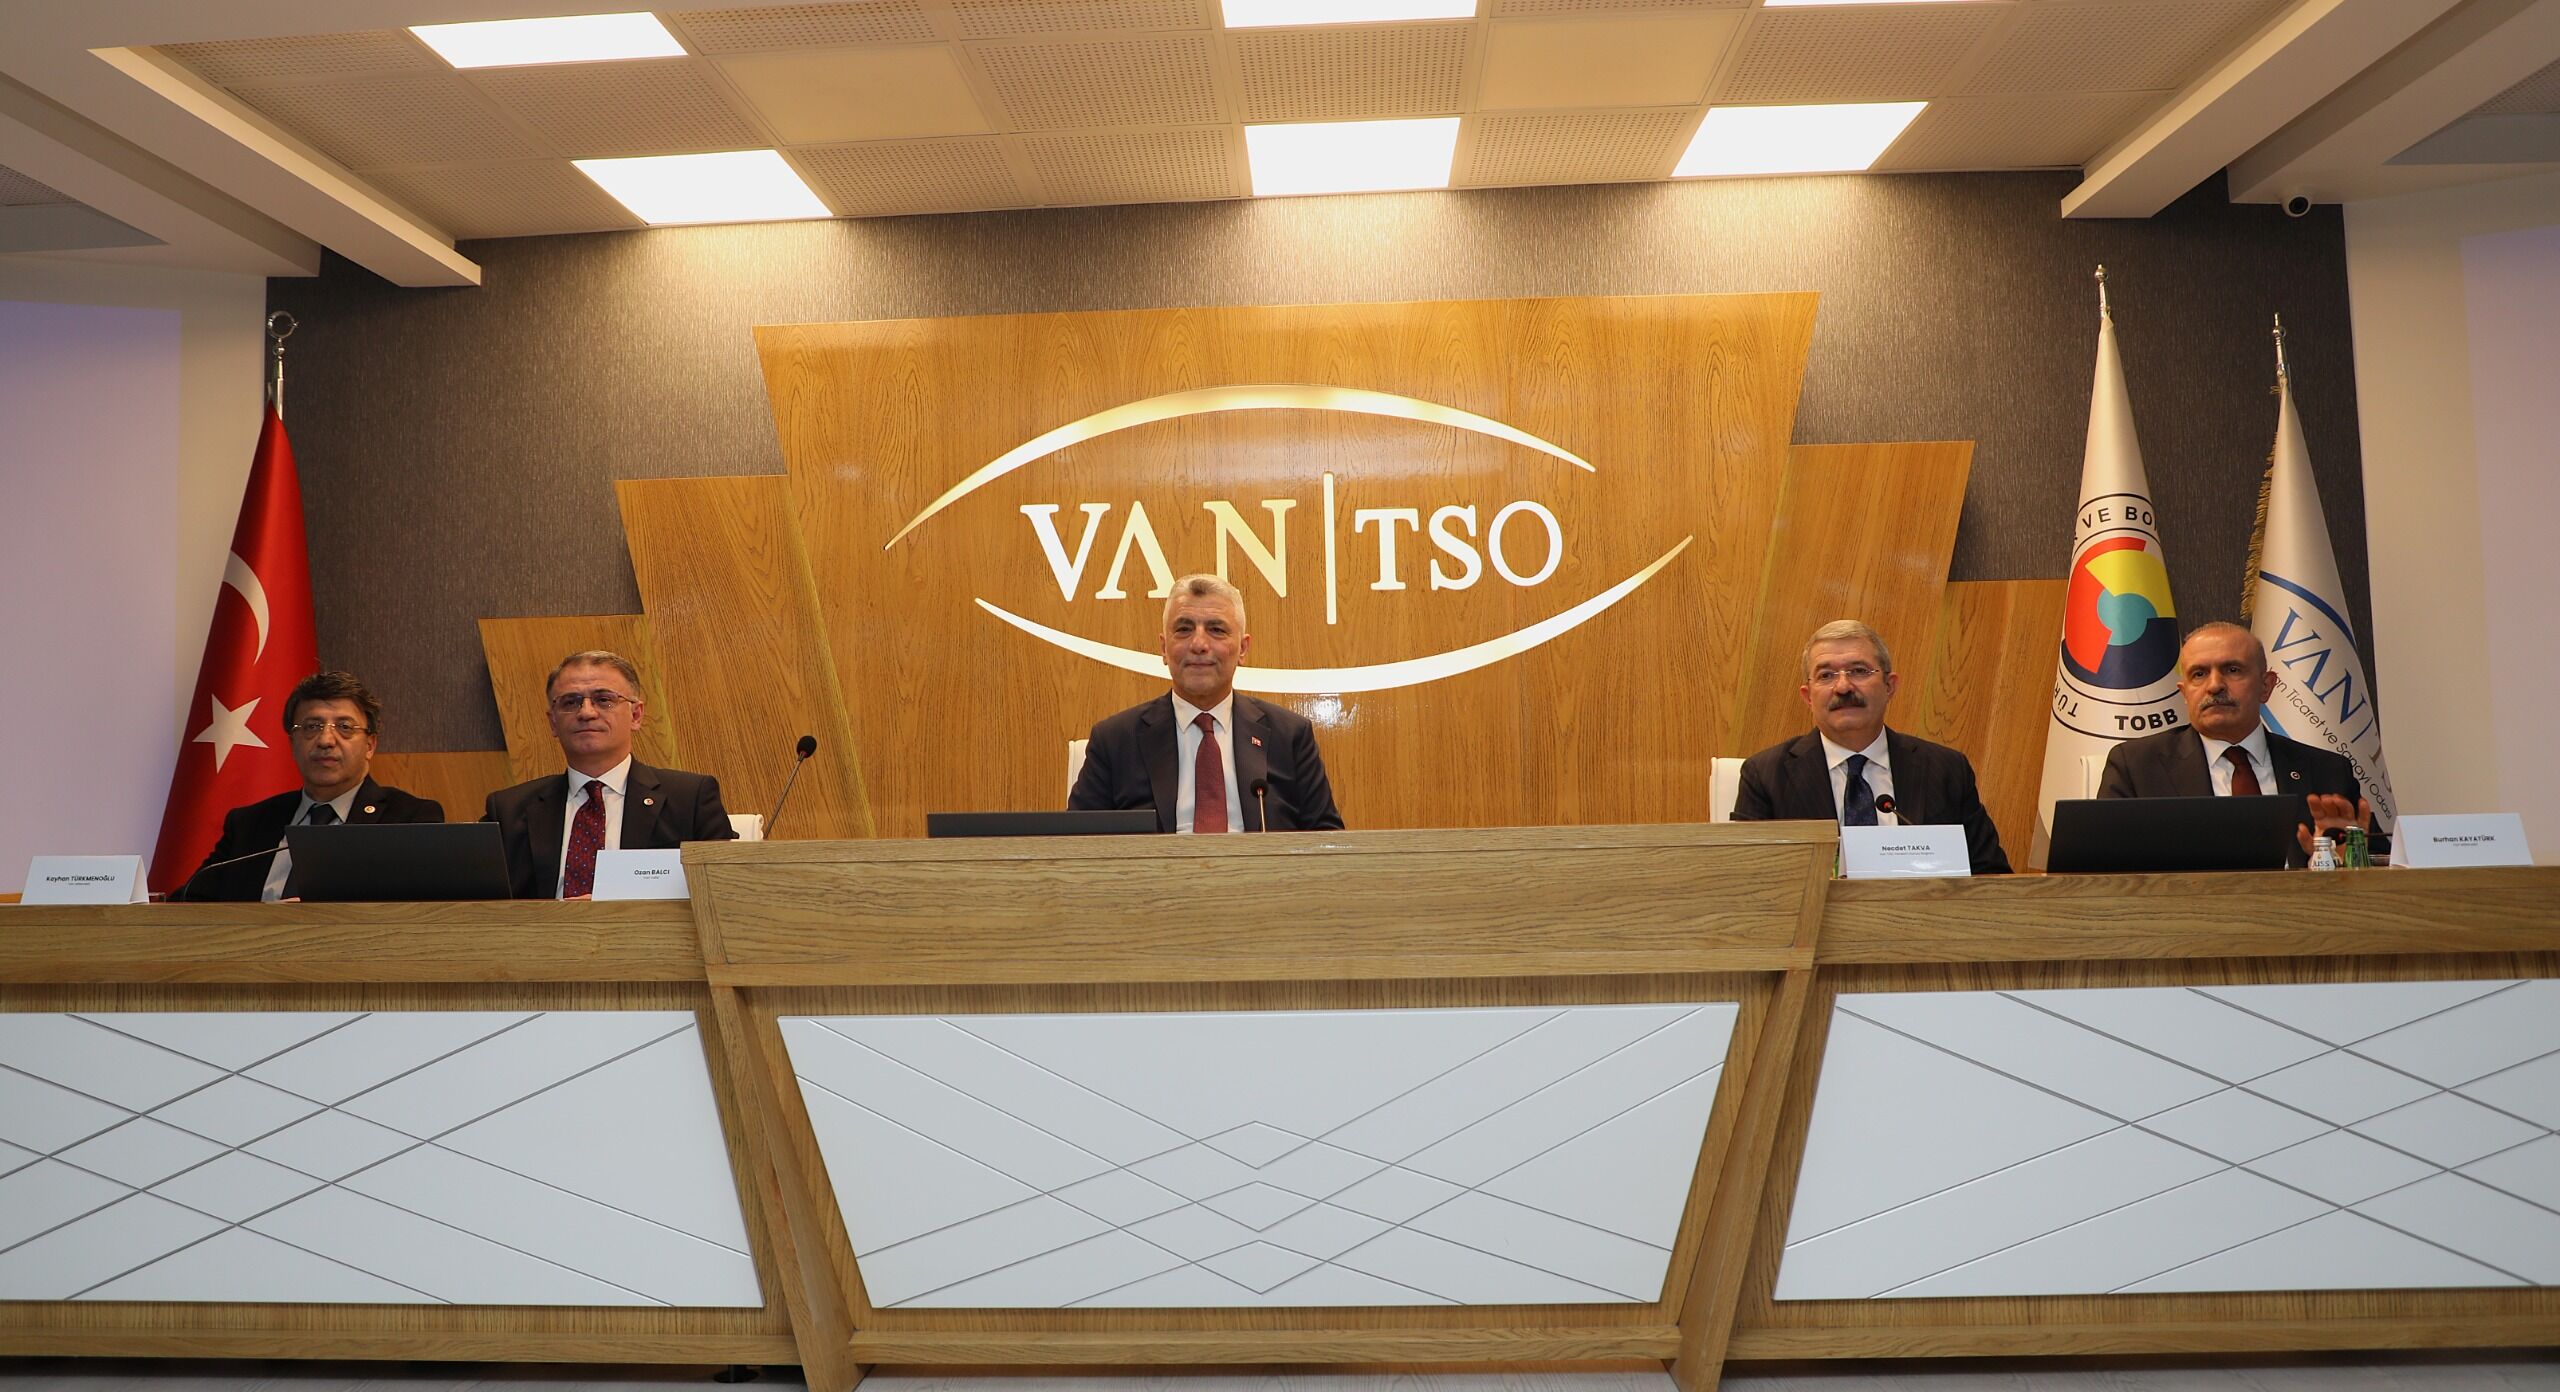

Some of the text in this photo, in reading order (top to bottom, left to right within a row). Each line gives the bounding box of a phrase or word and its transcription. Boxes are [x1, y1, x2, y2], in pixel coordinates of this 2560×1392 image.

[2082, 506, 2157, 531] VE BO
[1020, 499, 1563, 602] VAN TSO
[2271, 606, 2367, 725] VAN
[2114, 708, 2179, 731] TOBB
[2286, 688, 2326, 728] Ticaret
[2322, 727, 2338, 744] ve
[2336, 742, 2372, 784] Sanayi
[2459, 834, 2495, 842] KAYATÜRK
[46, 874, 115, 883] Kayhan TÜRKMENOĞLU
